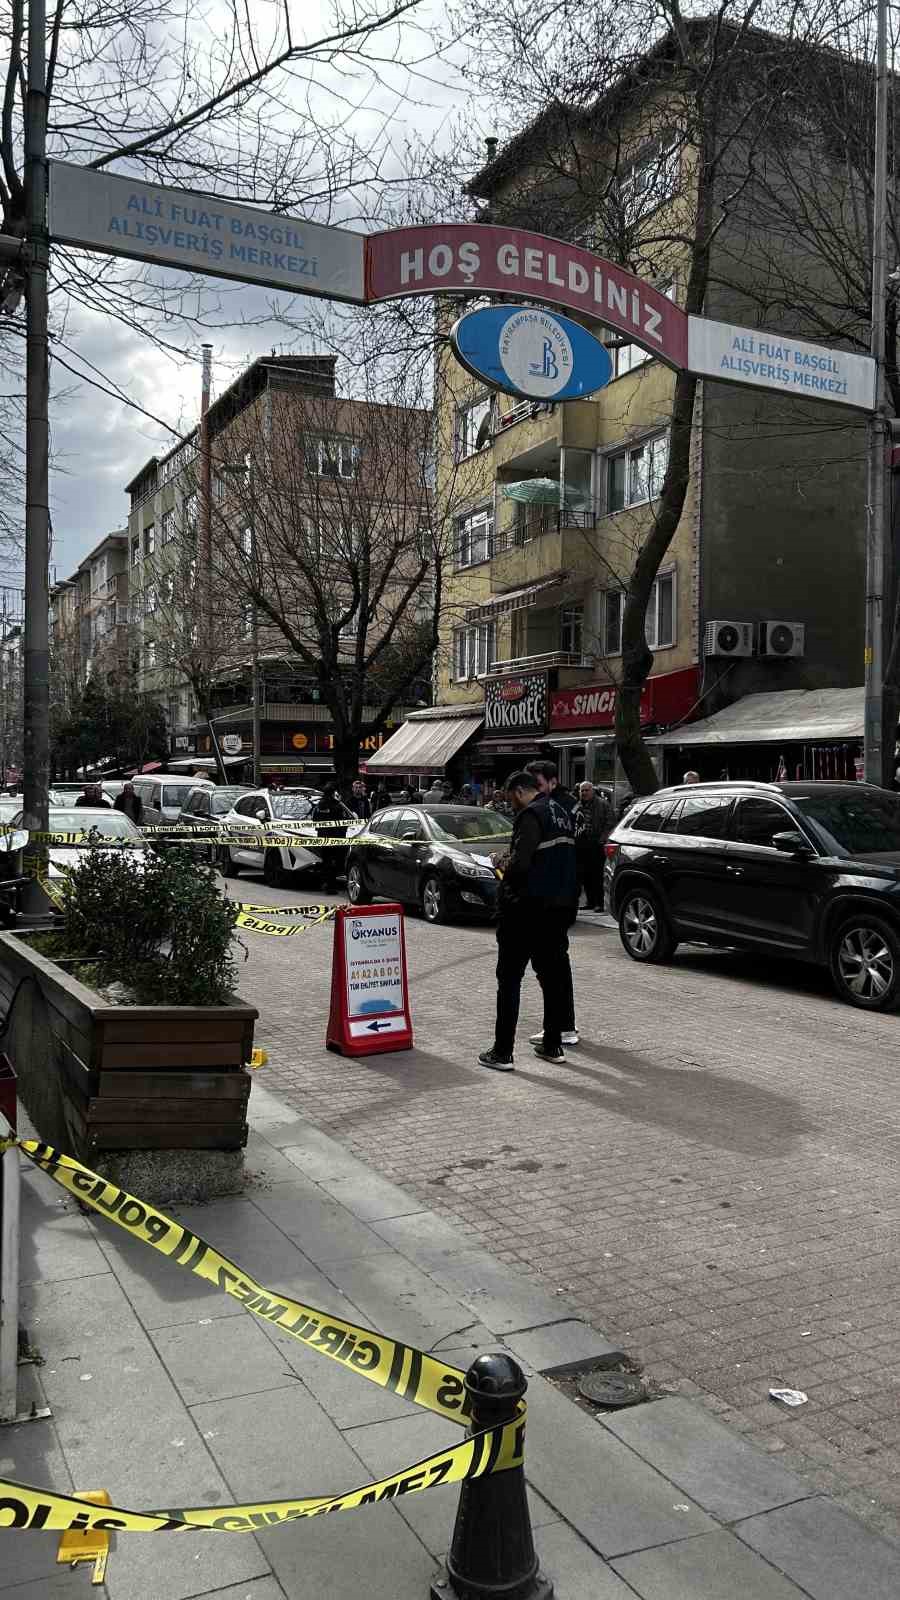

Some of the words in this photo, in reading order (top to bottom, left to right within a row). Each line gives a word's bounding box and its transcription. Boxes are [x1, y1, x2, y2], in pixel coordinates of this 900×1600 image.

[108, 216, 224, 260] ALIŞVERİŞ
[229, 243, 318, 278] MERKEZİ
[127, 194, 163, 218] ALİ
[171, 204, 224, 230] FUAT
[230, 218, 305, 250] BAŞGİL
[400, 242, 480, 283] HOŞ
[496, 244, 663, 344] GELDİNİZ
[720, 354, 790, 384] ALIŞVERİŞ
[793, 371, 848, 395] MERKEZİ
[732, 336, 754, 354] ALİ
[758, 343, 791, 363] FUAT
[794, 351, 839, 374] BAŞGİL
